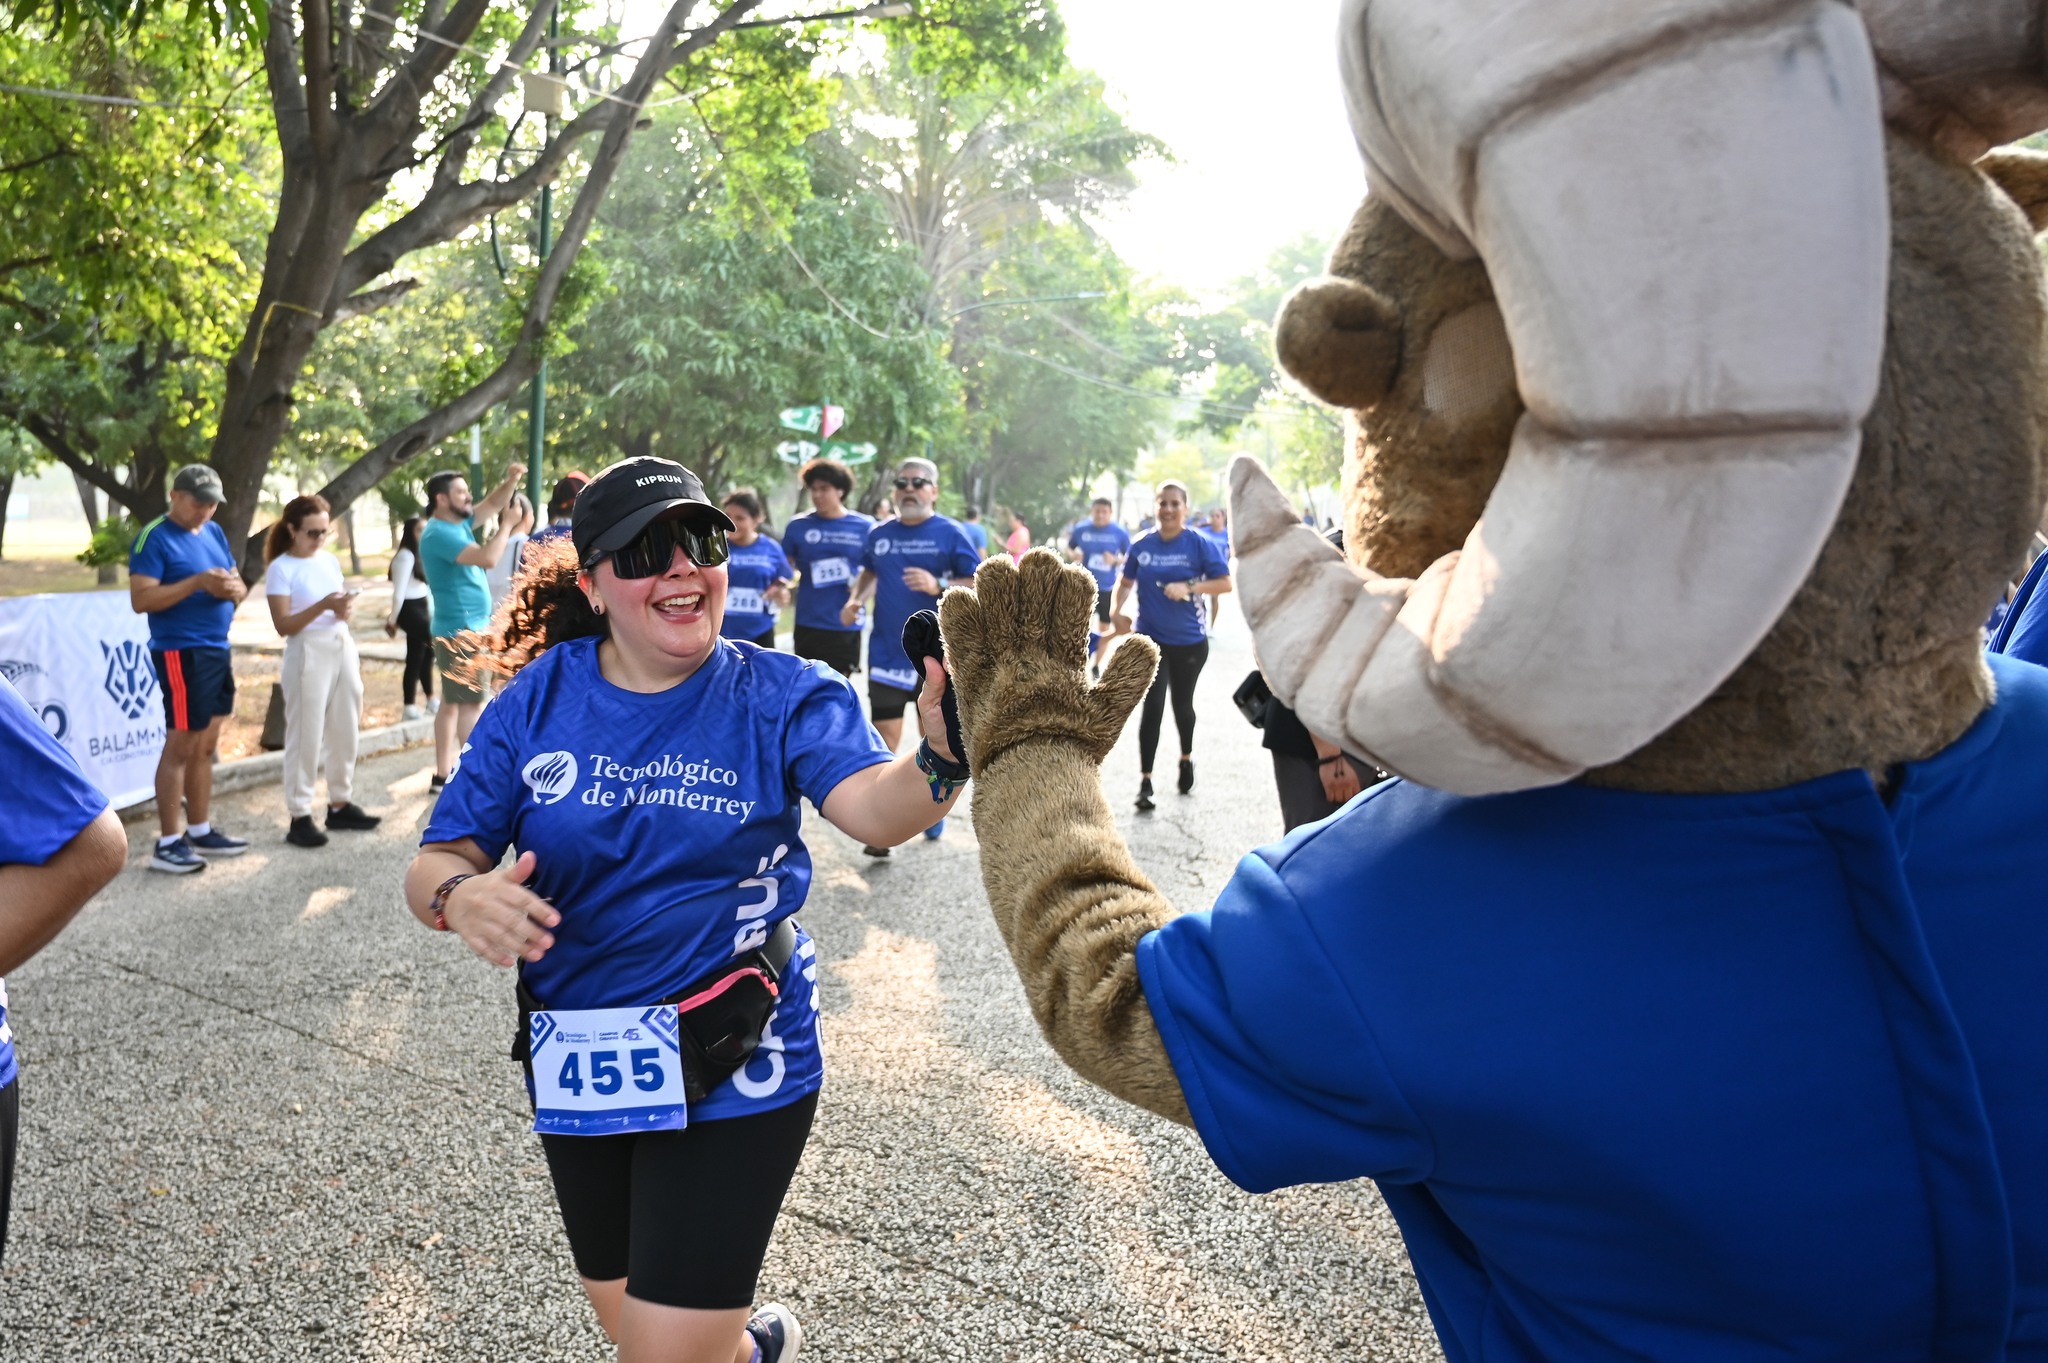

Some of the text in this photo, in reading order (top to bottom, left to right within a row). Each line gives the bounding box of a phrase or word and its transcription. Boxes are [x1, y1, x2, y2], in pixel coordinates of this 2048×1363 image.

[635, 474, 683, 487] KIPRUN
[589, 753, 739, 787] Tecnológico
[581, 782, 756, 825] de Monterrey
[558, 1047, 665, 1097] 455
